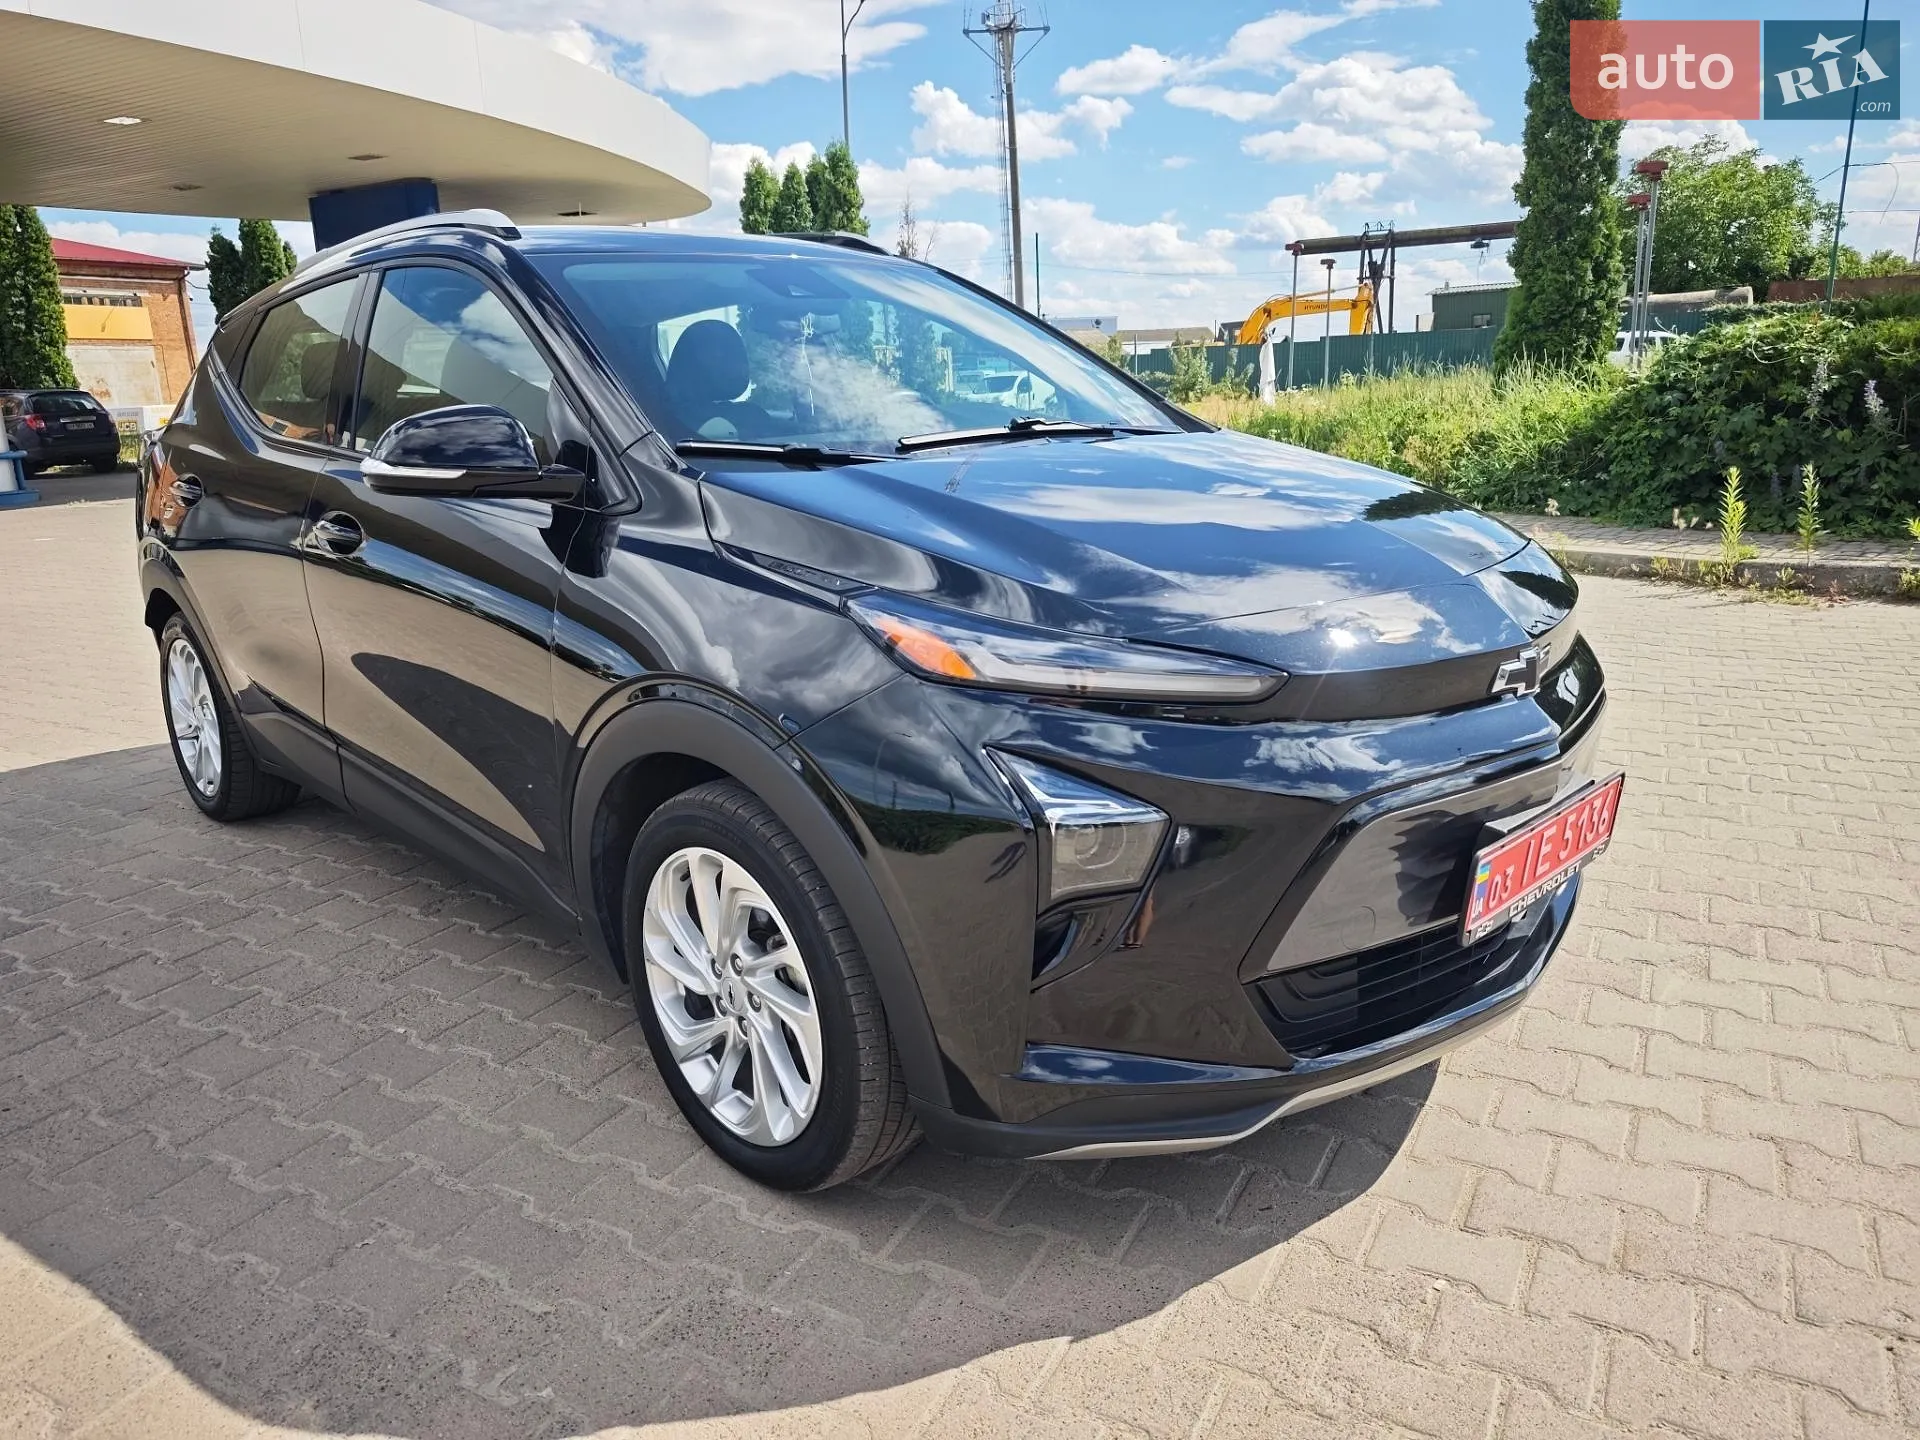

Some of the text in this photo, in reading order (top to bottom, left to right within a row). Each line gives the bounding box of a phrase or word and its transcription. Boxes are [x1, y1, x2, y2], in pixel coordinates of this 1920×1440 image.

[118, 422, 137, 431] JCB
[1489, 864, 1515, 909] 03
[1558, 788, 1615, 860] 5136
[1471, 897, 1483, 919] UA
[1509, 861, 1581, 917] CHEVROLET
